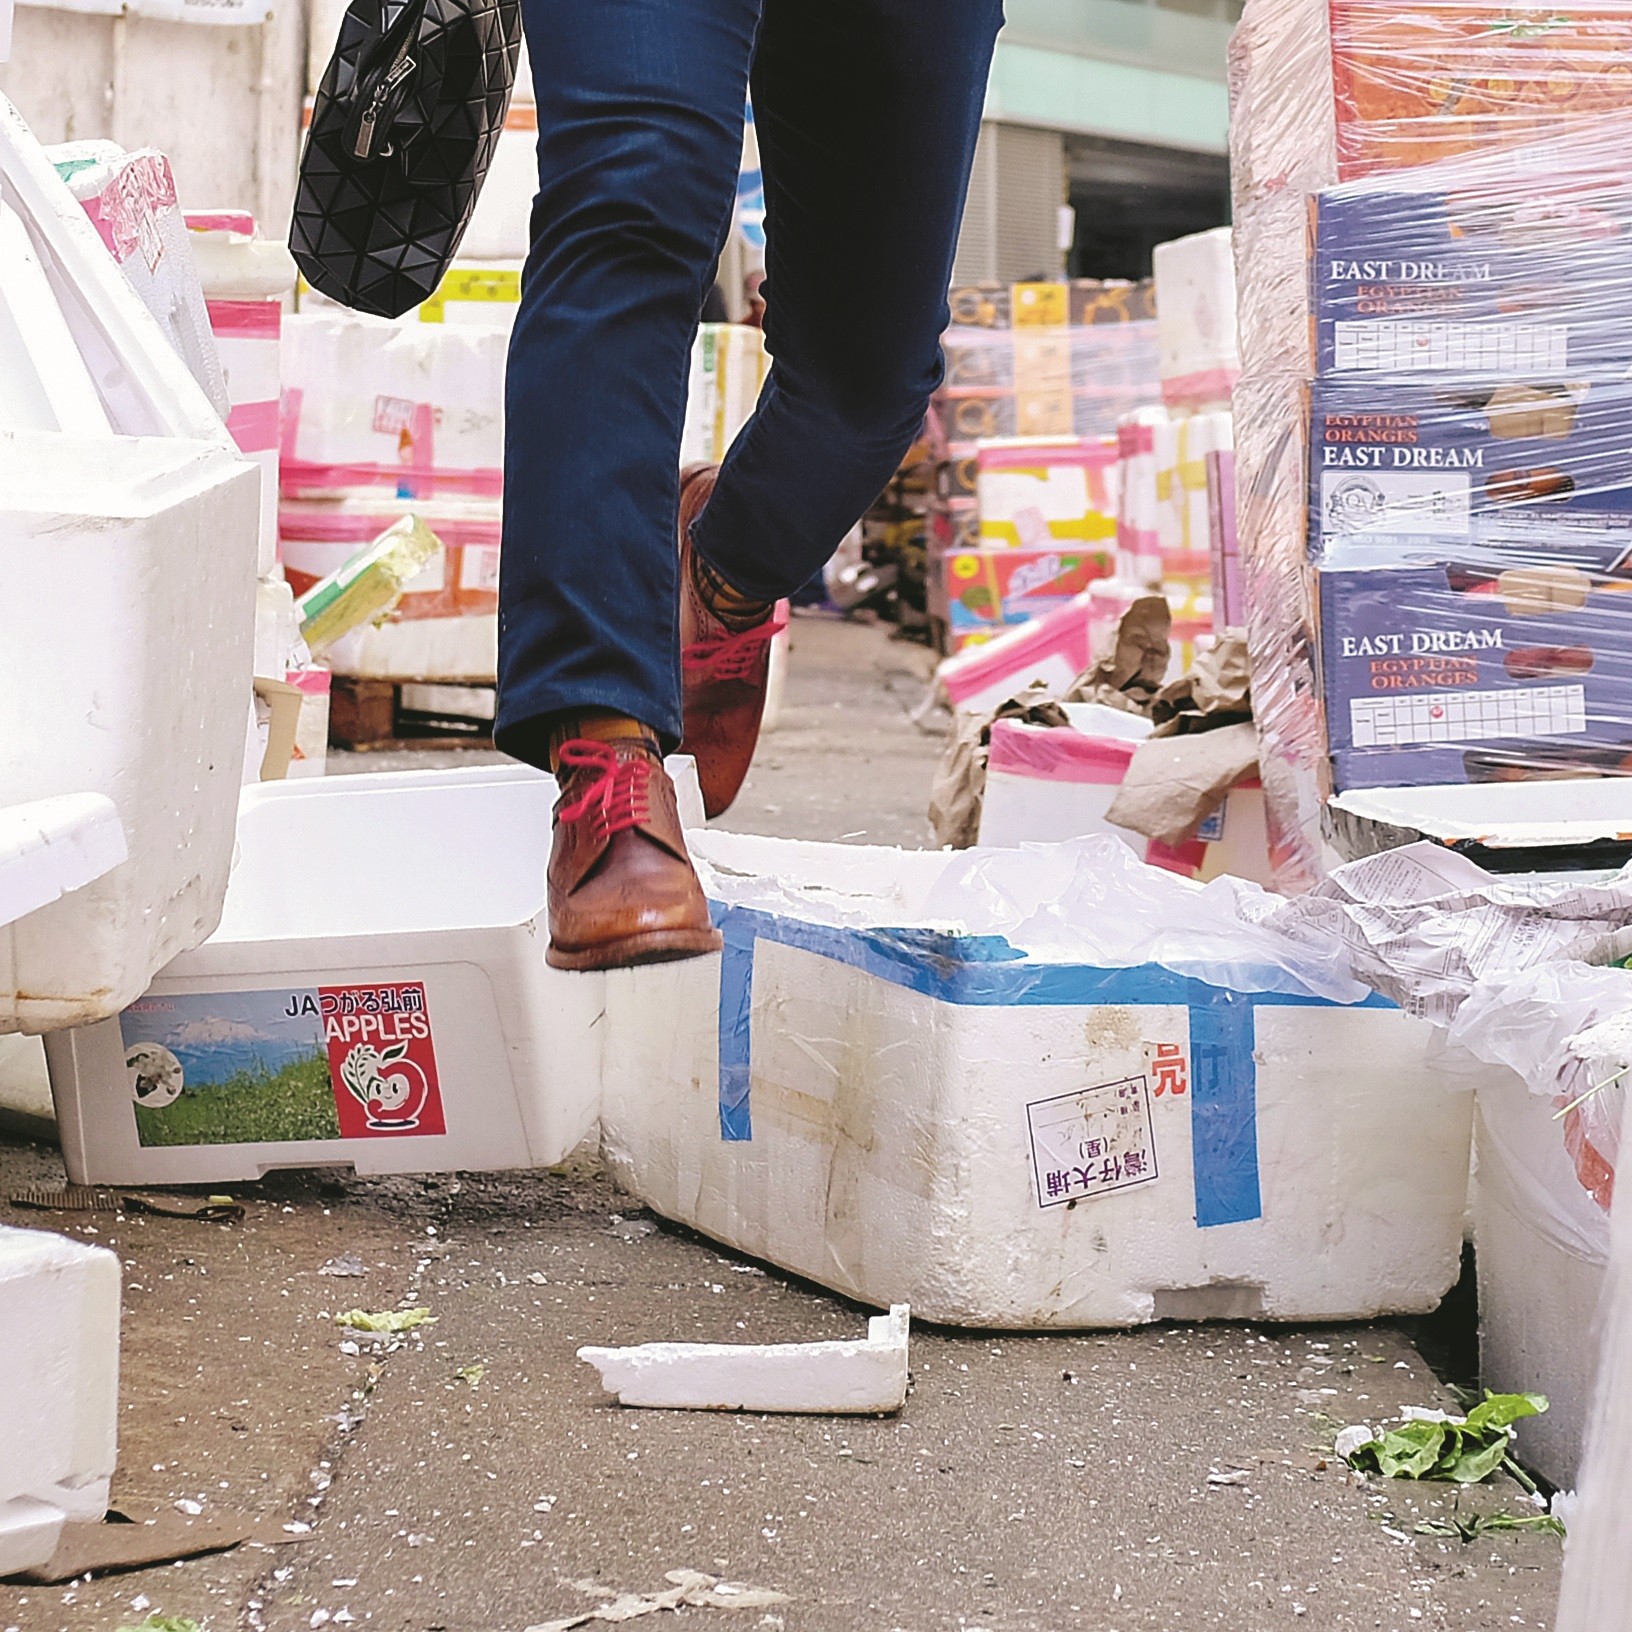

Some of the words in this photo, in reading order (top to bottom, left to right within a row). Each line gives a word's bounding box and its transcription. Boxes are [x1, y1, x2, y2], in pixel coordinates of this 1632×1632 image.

[1330, 260, 1391, 281] EAST
[1401, 261, 1491, 282] DREAM
[1324, 413, 1420, 428] EGYPTIAN
[1324, 428, 1418, 443] ORANGES
[1322, 446, 1385, 467] EAST
[1393, 447, 1484, 468] DREAM
[1341, 633, 1403, 657] EAST
[1412, 628, 1504, 653] DREAM
[1369, 654, 1478, 674] EGYPTIAN
[1370, 670, 1478, 691] ORANGES
[324, 1012, 430, 1045] APPLES
[1046, 1149, 1148, 1198] 灣仔大埔
